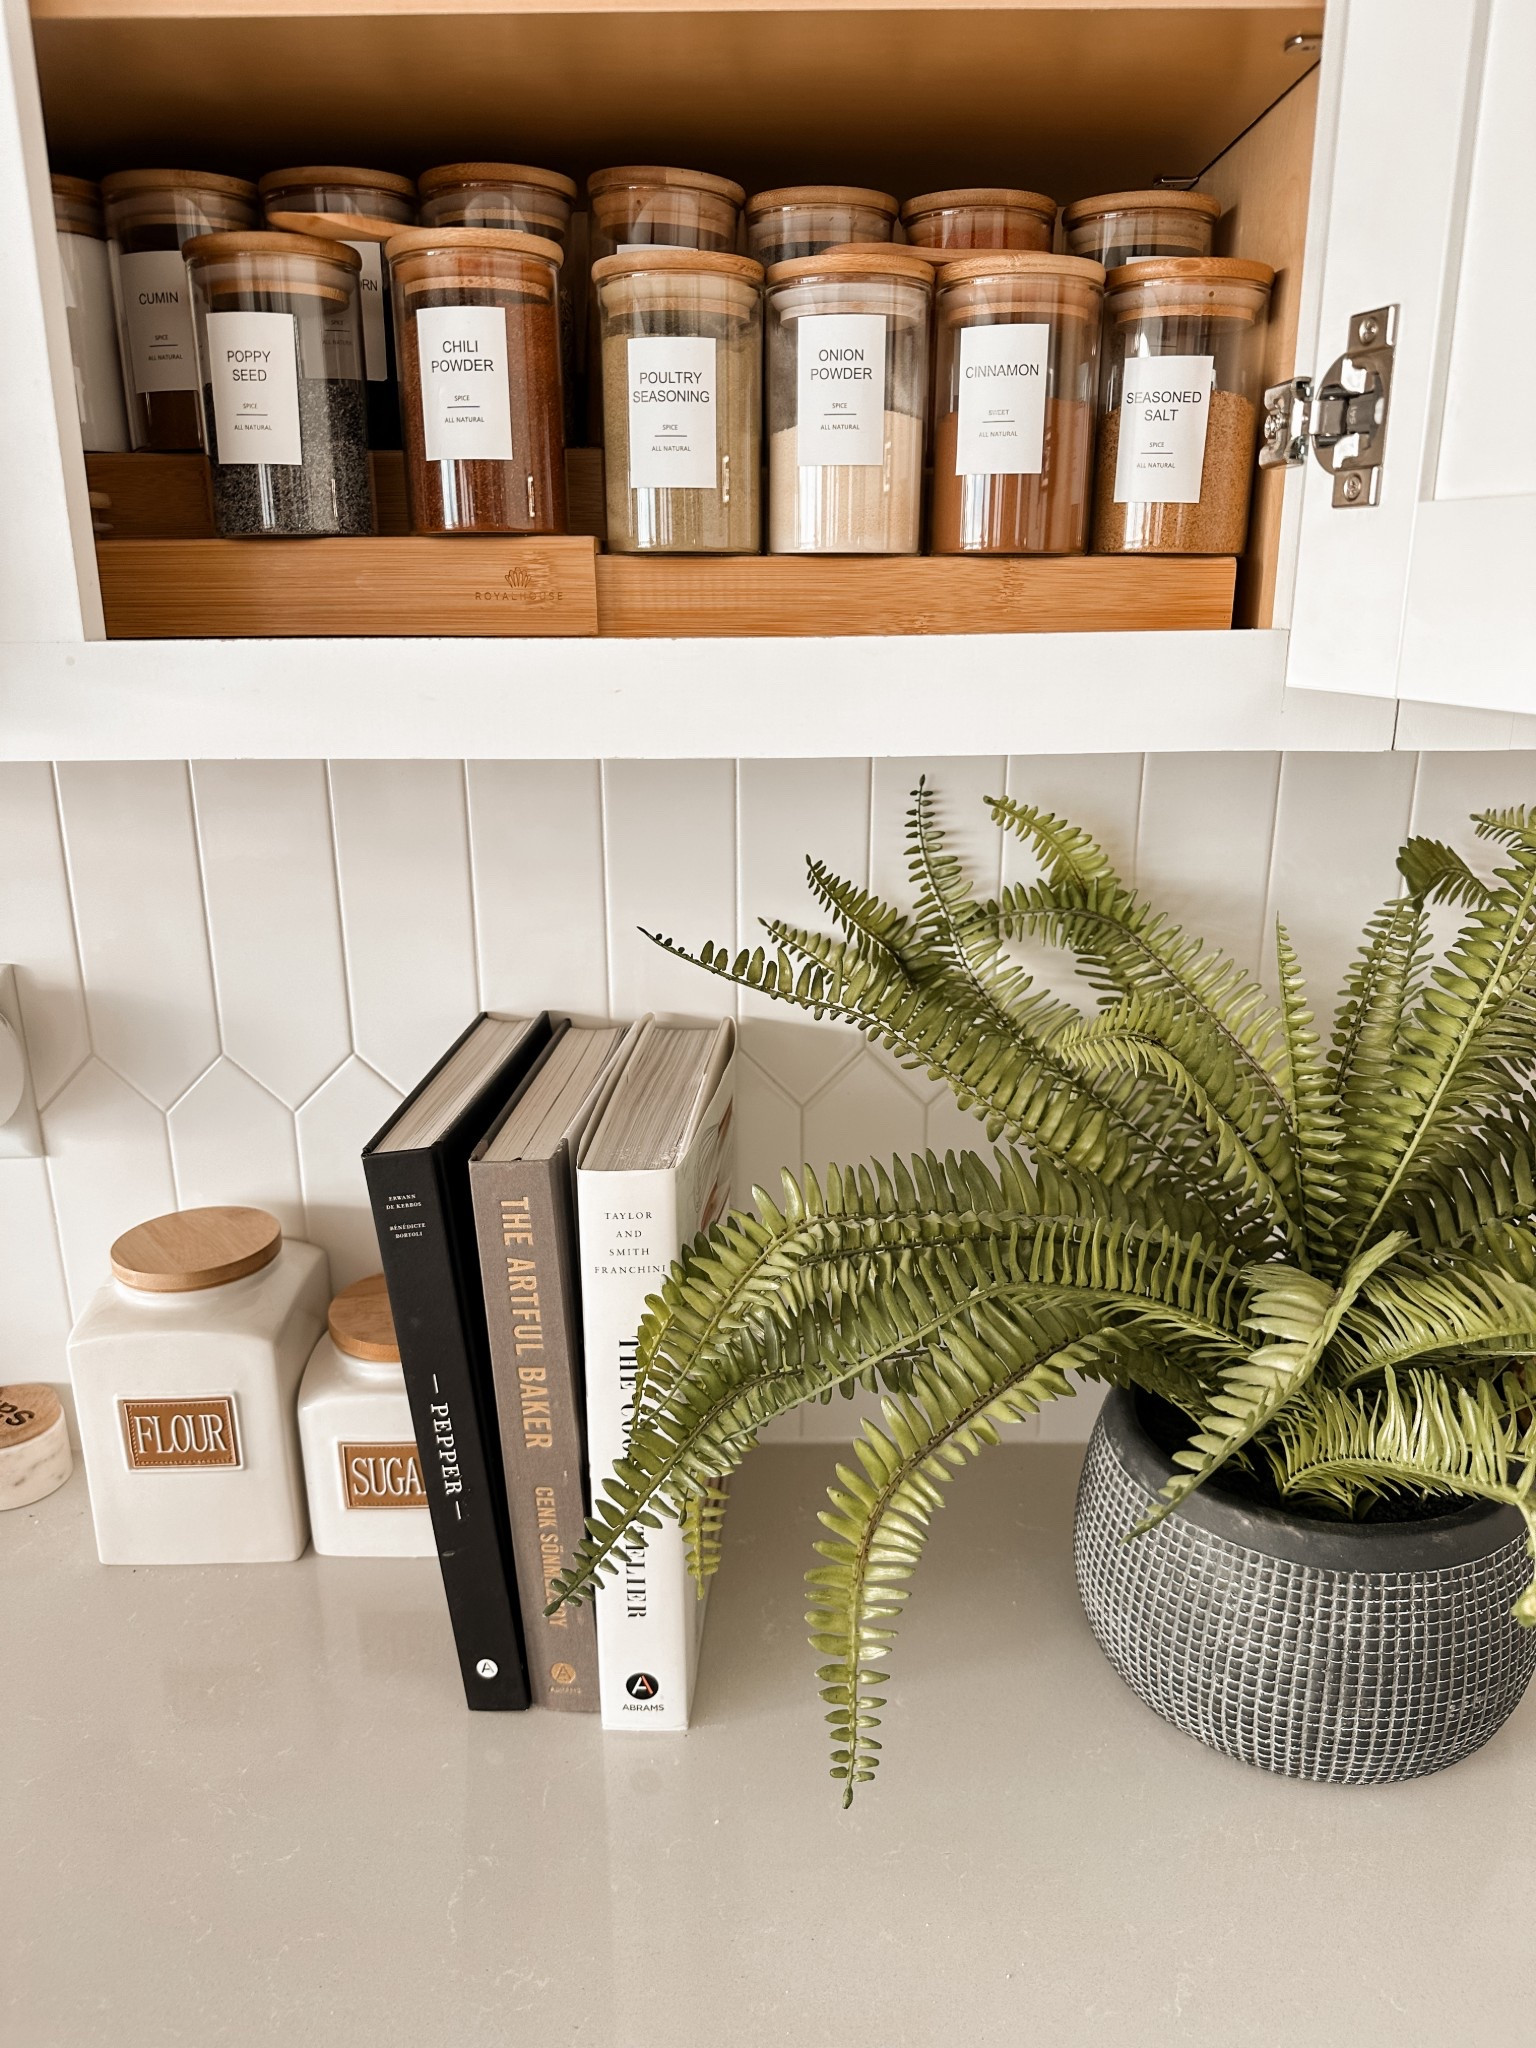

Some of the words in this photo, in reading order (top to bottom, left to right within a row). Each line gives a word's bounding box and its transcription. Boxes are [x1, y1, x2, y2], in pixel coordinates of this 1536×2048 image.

[138, 291, 179, 305] CUMIN
[442, 340, 479, 353] CHILI
[158, 353, 183, 361] NATURAL
[226, 350, 271, 363] POPPY
[818, 348, 865, 362] ONION
[431, 359, 494, 373] POWDER
[965, 363, 1040, 379] CINNAMON
[232, 369, 267, 382] SEED
[639, 371, 703, 384] POULTRY
[810, 367, 873, 381] POWDER
[632, 390, 710, 403] SEASONING
[1126, 390, 1202, 404] SEASONED
[456, 416, 485, 424] NATURAL
[1143, 408, 1179, 421] SALT
[474, 591, 564, 601] ROYALHOUSE
[500, 1196, 534, 1247] THE
[604, 1211, 653, 1220] TAYLOR
[616, 1230, 643, 1239] AND
[609, 1248, 650, 1257] SMITH
[594, 1264, 667, 1275] FRANCHINI
[506, 1257, 546, 1356] ARTFUL
[517, 1366, 553, 1449] BAKER
[133, 1413, 228, 1455] FLOUR
[430, 1401, 464, 1496] PEPPER
[351, 1455, 427, 1497] SUGA
[534, 1485, 558, 1528] CENK
[622, 1703, 665, 1712] ABRAMS
